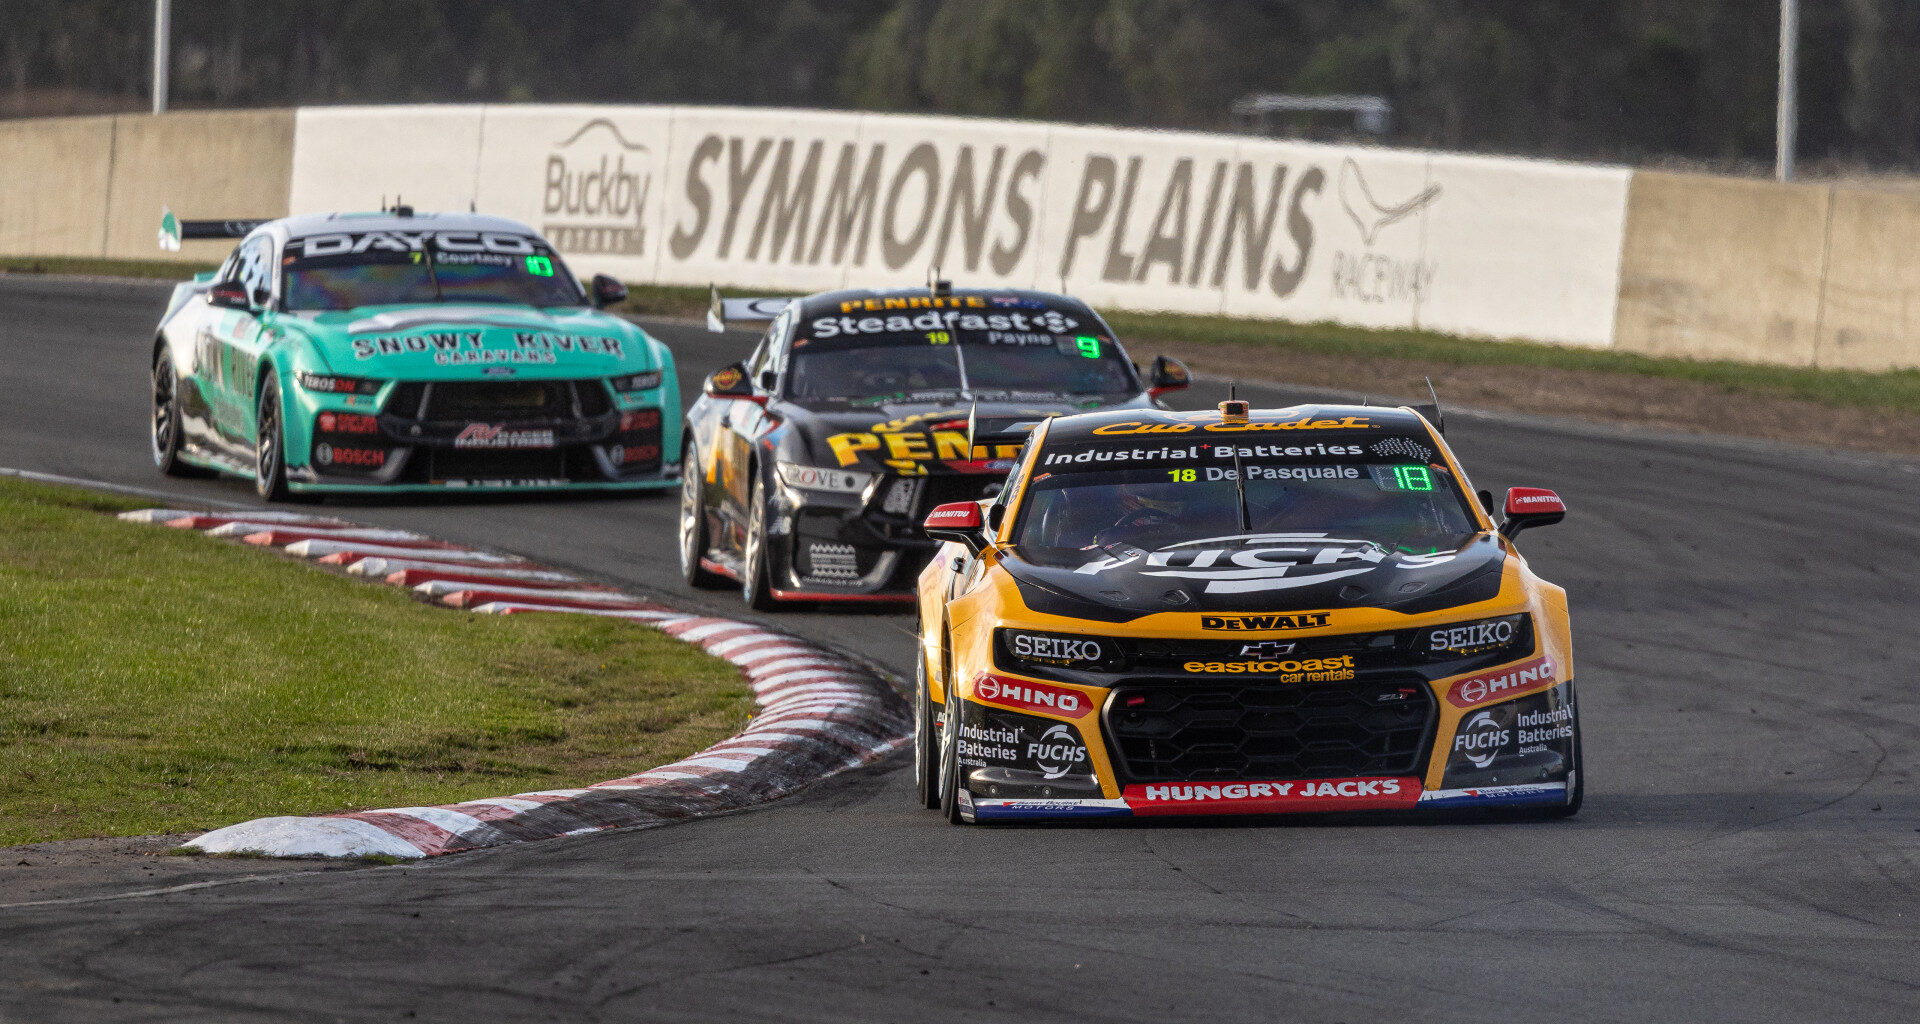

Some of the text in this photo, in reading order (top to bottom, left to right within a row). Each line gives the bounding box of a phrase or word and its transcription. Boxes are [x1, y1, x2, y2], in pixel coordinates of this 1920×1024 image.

[543, 153, 651, 226] Buckby
[668, 134, 1325, 299] SYMMONS PLAINS
[303, 231, 534, 258] DAYCO
[409, 251, 421, 264] 7
[841, 296, 985, 313] PENRITE
[812, 311, 1031, 338] Steadfast
[351, 332, 625, 359] SNOWY RIVER
[925, 331, 1053, 346] 19 Payne
[1076, 335, 1100, 359] 9
[434, 350, 556, 365] CARAVANS
[1092, 417, 1370, 435] Cub Cadet
[333, 446, 384, 466] BOSCH
[1214, 443, 1364, 458] Batteries
[1167, 465, 1359, 483] 18 De Pasquale
[1393, 466, 1432, 491] 18
[1522, 496, 1560, 504] MANITOU
[933, 511, 970, 519] MANITOU
[1430, 621, 1512, 651] SEIKO
[1015, 634, 1101, 661] SEIKO
[1183, 655, 1355, 673] eastcoast
[1280, 668, 1354, 684] car rentals
[1489, 662, 1551, 693] HINO
[1002, 683, 1079, 711] HINO
[1455, 730, 1509, 751] FUCHS
[1518, 725, 1573, 743] Batteries
[957, 740, 1017, 760] Batteries
[1027, 743, 1086, 762] FUCHS
[1519, 743, 1547, 754] Australia
[957, 757, 987, 768] Australia
[1145, 779, 1400, 801] HUNGRY JACK'S
